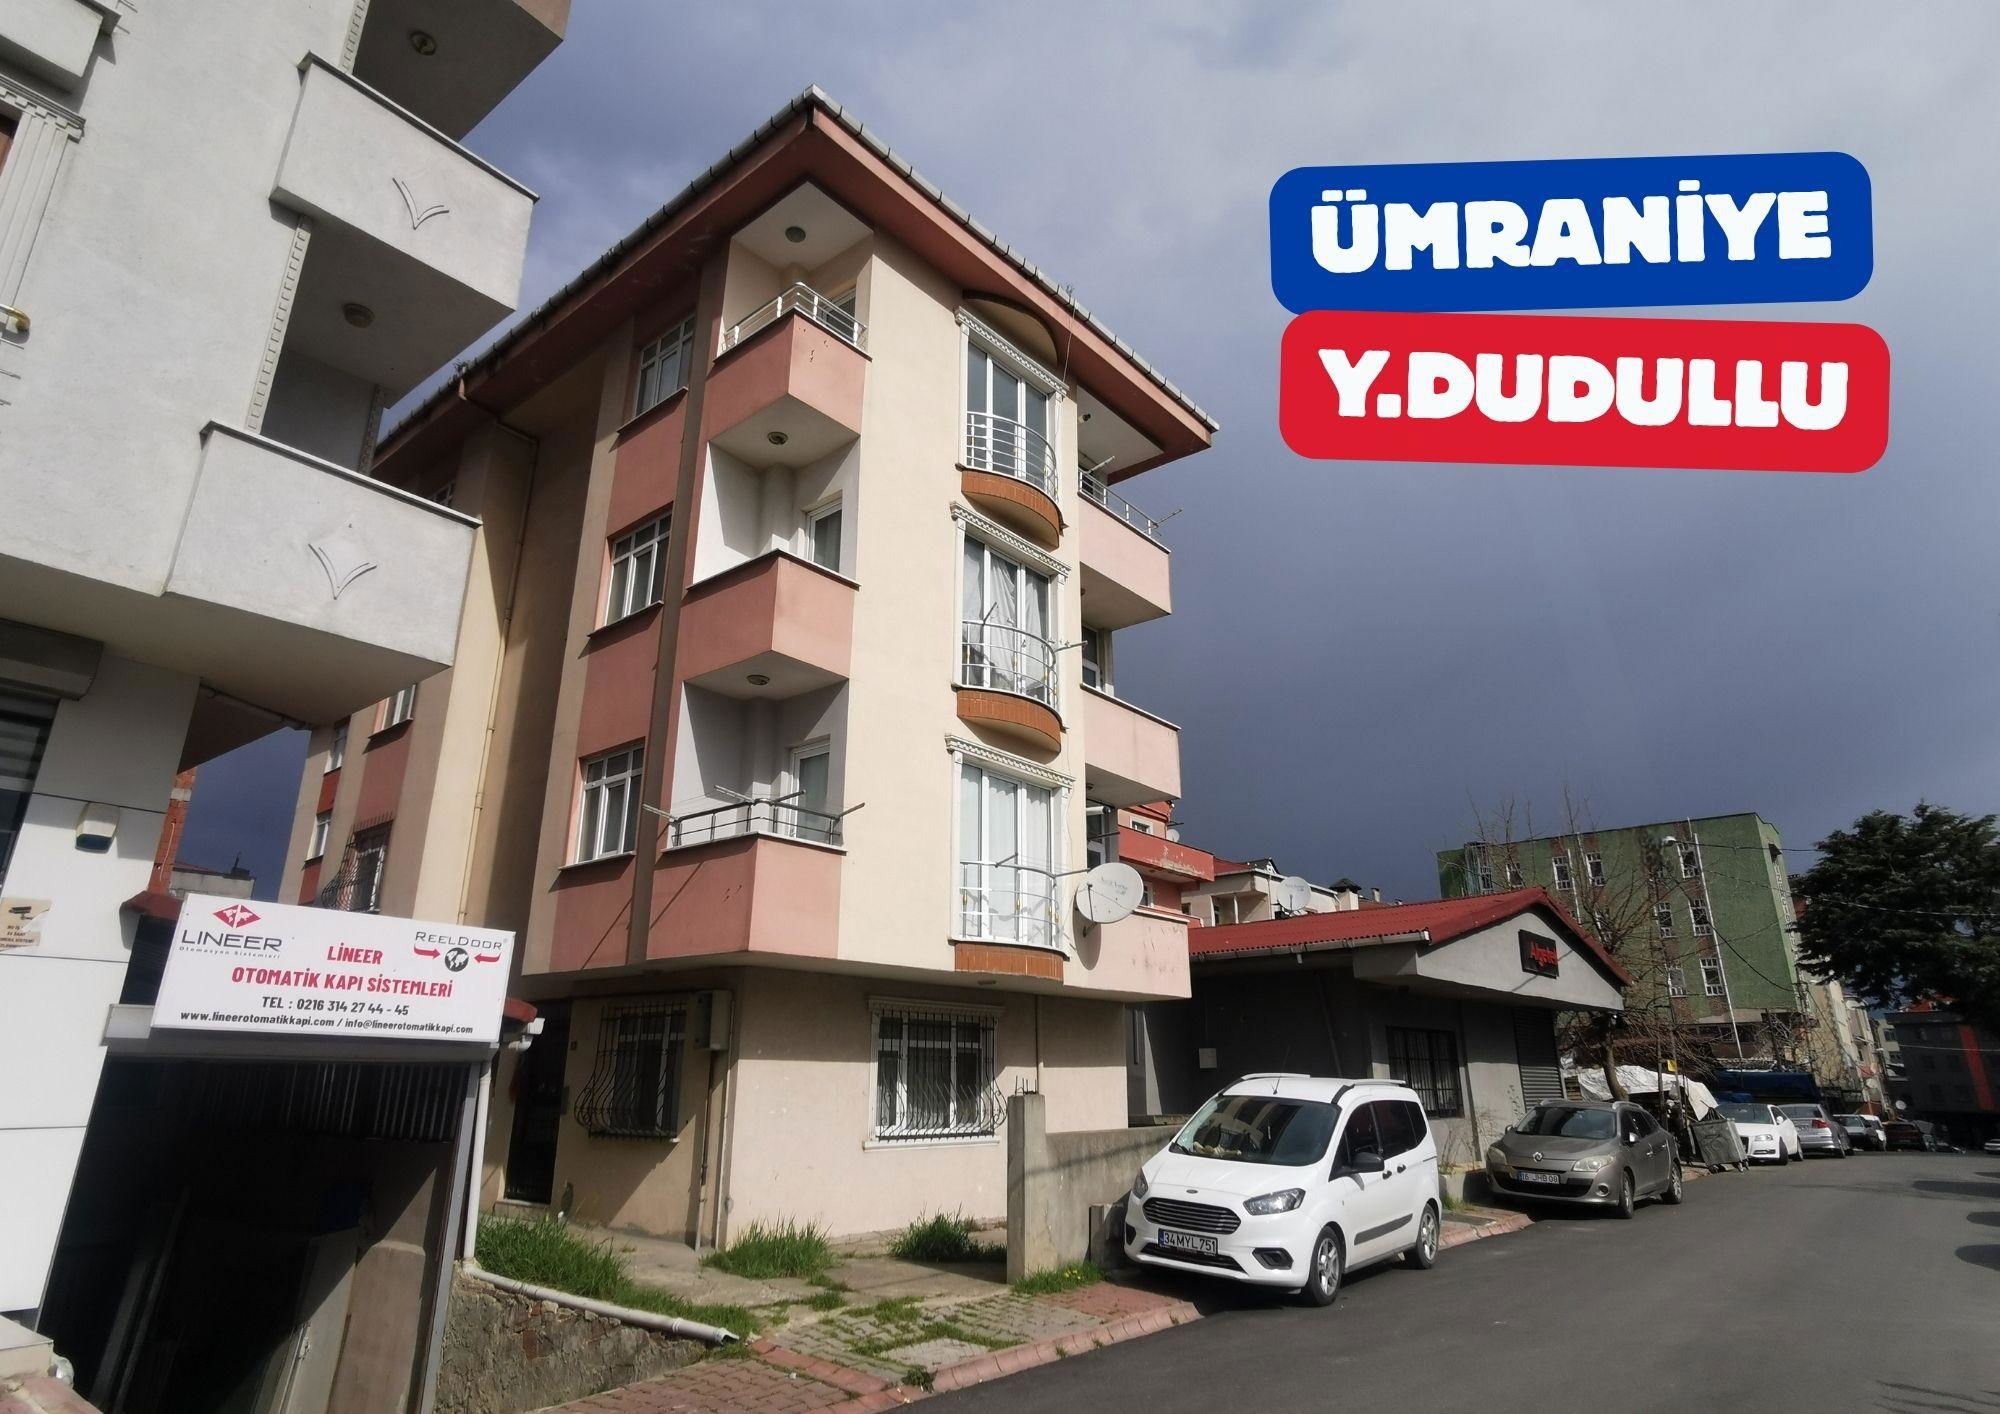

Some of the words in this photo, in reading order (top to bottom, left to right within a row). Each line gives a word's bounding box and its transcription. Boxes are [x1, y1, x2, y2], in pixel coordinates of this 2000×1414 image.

[181, 929, 283, 952] LINEER
[327, 942, 383, 965] LİNEER
[231, 966, 321, 989] OTOMATİK
[324, 973, 363, 991] KAPI
[366, 974, 453, 998] SİSTEMLERİ
[262, 996, 284, 1009] TEL
[296, 998, 325, 1011] 0216
[327, 1000, 348, 1013] 314
[350, 1002, 366, 1014] 27
[368, 1003, 384, 1015] 44
[394, 1005, 410, 1016] 45
[180, 1011, 335, 1027] www.lineerotomatikkapi.com
[345, 1018, 474, 1034] info@lineerotomatikkapi.com
